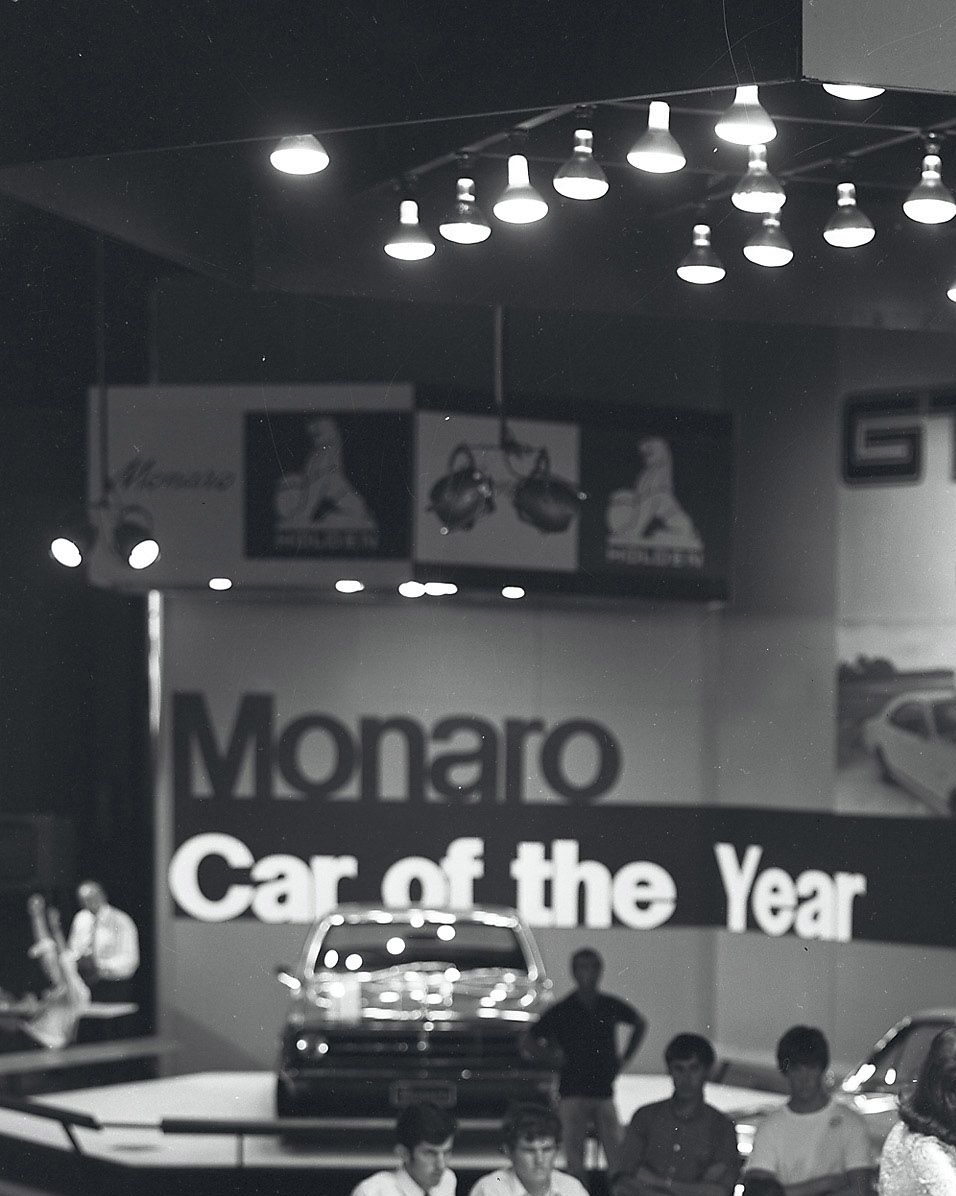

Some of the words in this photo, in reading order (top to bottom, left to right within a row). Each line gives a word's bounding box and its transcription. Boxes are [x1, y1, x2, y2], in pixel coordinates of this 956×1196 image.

[113, 457, 237, 492] Monaro
[273, 532, 379, 551] HOLDEN
[605, 546, 703, 570] HOLDEN
[172, 691, 622, 802] Monaro
[168, 832, 358, 922] Car
[381, 837, 485, 909] of
[511, 839, 677, 928] the
[714, 842, 867, 940] Year
